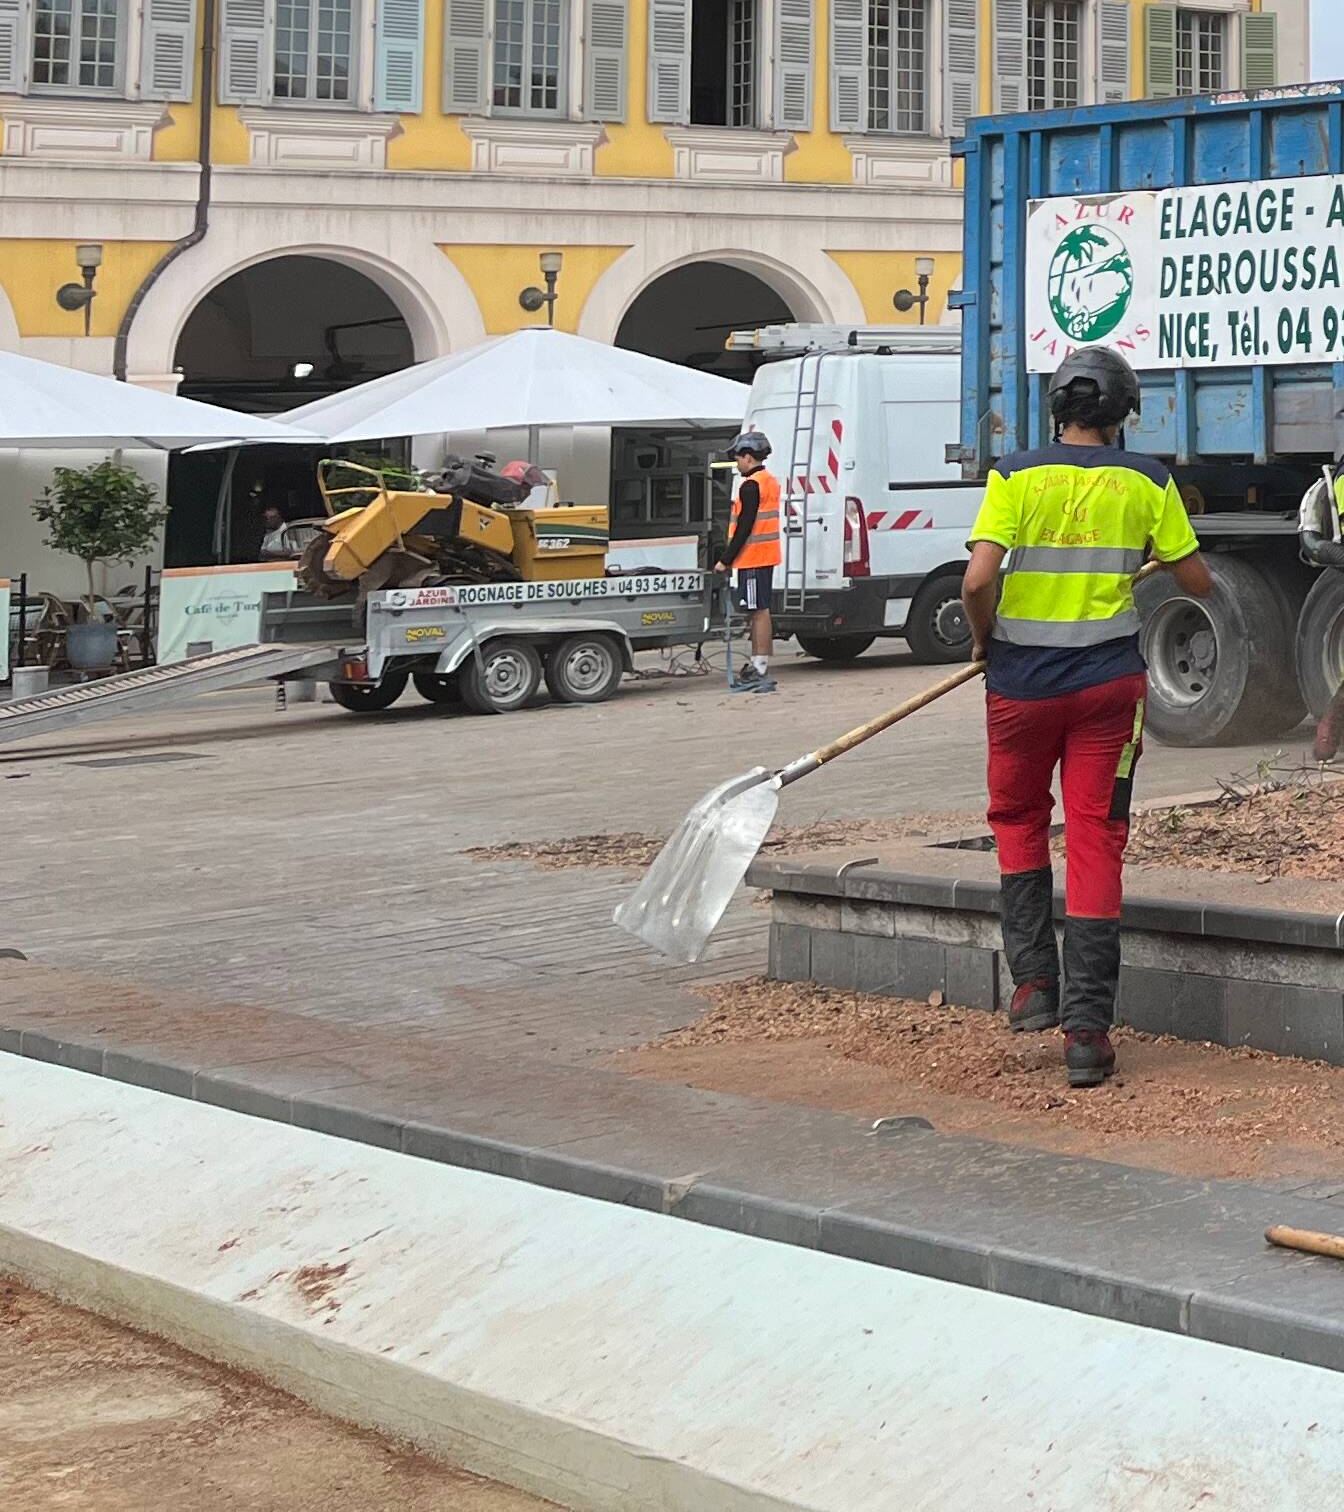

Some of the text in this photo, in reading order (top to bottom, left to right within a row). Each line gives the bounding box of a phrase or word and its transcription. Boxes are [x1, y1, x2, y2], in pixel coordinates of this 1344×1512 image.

[1055, 203, 1136, 231] AZUR
[1160, 188, 1295, 240] ELAGAGE
[1030, 323, 1151, 358] JARNS
[1158, 311, 1218, 362] NICE,
[1227, 306, 1270, 356] Tél.
[1277, 307, 1312, 354] 04
[409, 596, 455, 606] JARDINS
[418, 590, 447, 598] AZUR
[458, 585, 523, 603] ROGNAGE
[527, 584, 544, 599] DE
[547, 581, 608, 598] SOUCHES
[635, 578, 650, 592] 93
[653, 577, 667, 591] 54
[671, 576, 684, 590] 12
[688, 575, 701, 589] 21
